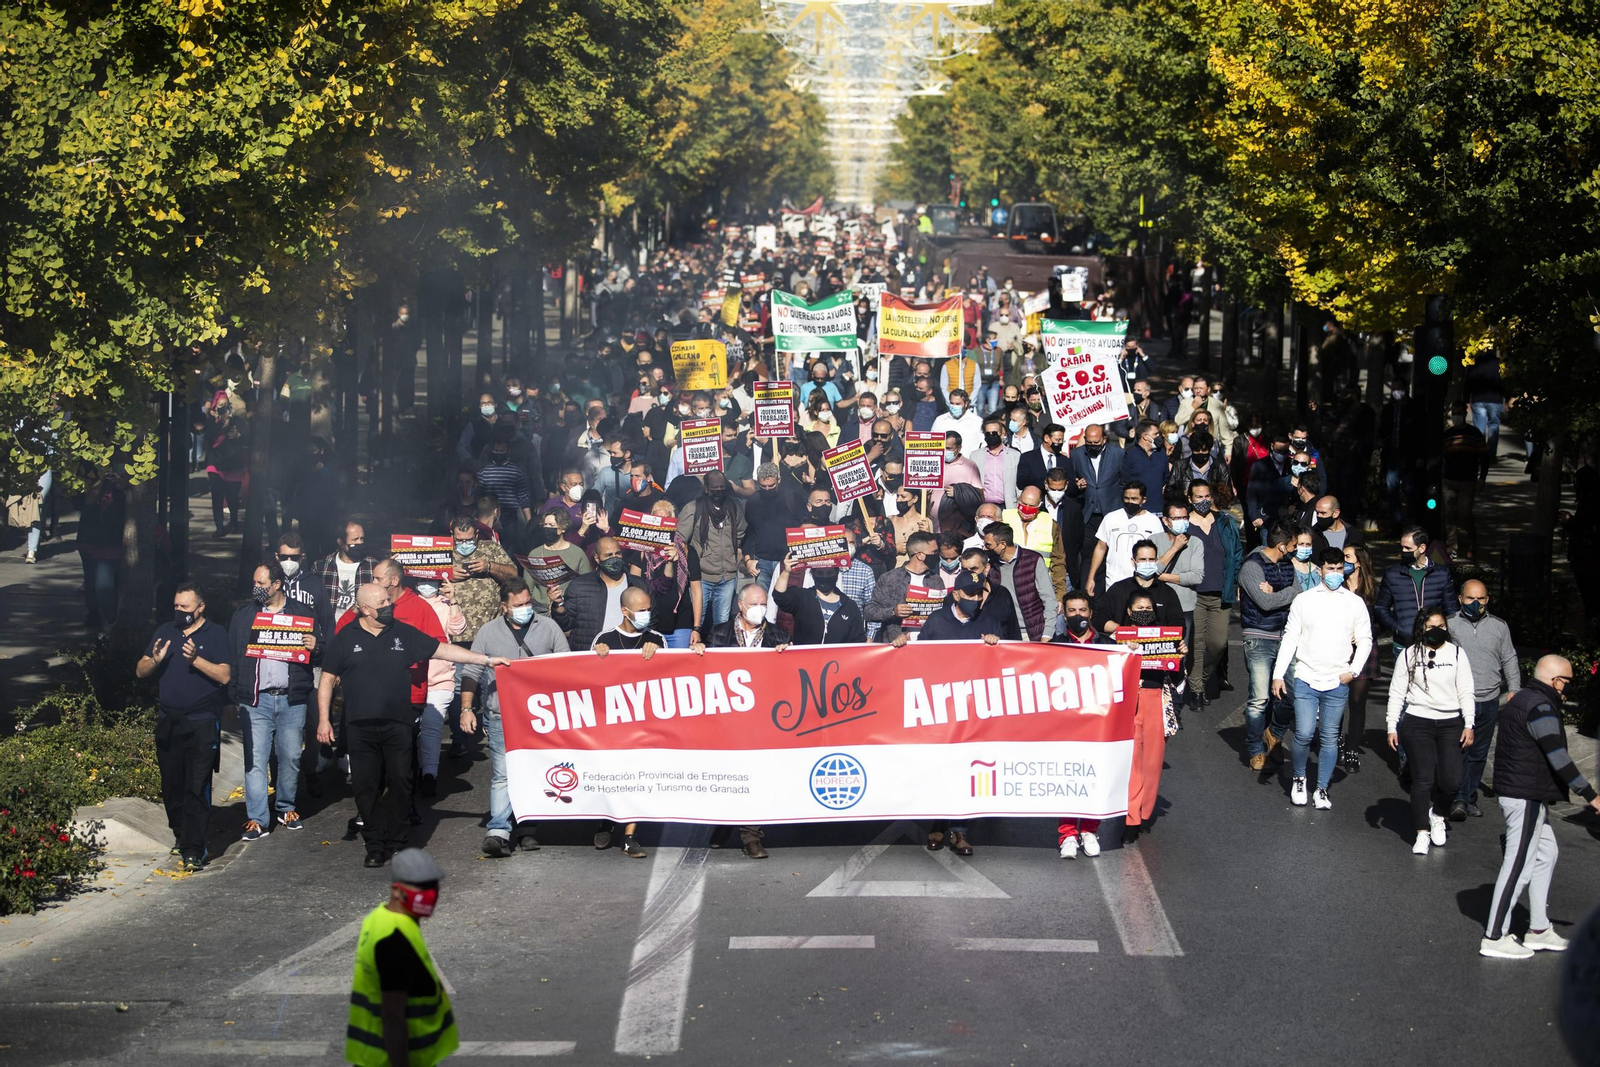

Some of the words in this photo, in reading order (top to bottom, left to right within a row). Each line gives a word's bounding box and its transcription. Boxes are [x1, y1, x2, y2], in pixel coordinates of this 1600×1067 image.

[778, 307, 788, 318] NO
[790, 310, 824, 320] QUEREMOS
[826, 307, 852, 320] AYUDAS
[930, 315, 940, 324] NO
[942, 315, 958, 323] TIENE
[780, 322, 816, 334] QUEREMOS
[818, 323, 852, 334] TRABAJAR
[883, 326, 889, 334] LA
[890, 328, 908, 337] CULPA
[909, 330, 920, 338] LOS
[1044, 336, 1056, 346] NO
[1098, 339, 1124, 348] AYUDAS
[1056, 364, 1109, 390] S.O.S.
[1056, 404, 1073, 419] NOS
[686, 427, 717, 437] MANIFESTACIÓN
[688, 452, 717, 460] TRABAJAR!
[830, 449, 861, 465] MANIFESTACIÓN
[838, 472, 868, 487] TRABAJAR!
[644, 530, 671, 539] EMPLEOS
[260, 630, 272, 639] MÁS
[1145, 642, 1174, 651] EMPLEOS
[527, 688, 597, 734] SIN
[605, 669, 756, 725] AYUDAS
[771, 659, 873, 732] Nos
[903, 653, 1124, 728] Arruinan!
[1004, 760, 1097, 778] HOSTELERÍA
[582, 771, 636, 781] Federación
[638, 771, 684, 781] Provincial
[686, 771, 700, 781] de
[702, 772, 749, 783] Empresas
[815, 776, 860, 785] HORECA
[584, 784, 596, 792] de
[597, 784, 646, 793] Hostelería
[648, 786, 653, 794] y
[655, 783, 692, 793] Turismo
[696, 784, 708, 793] de
[711, 784, 750, 794] Granada
[1004, 782, 1023, 796] DE
[1030, 780, 1089, 798] ESPAÑA
